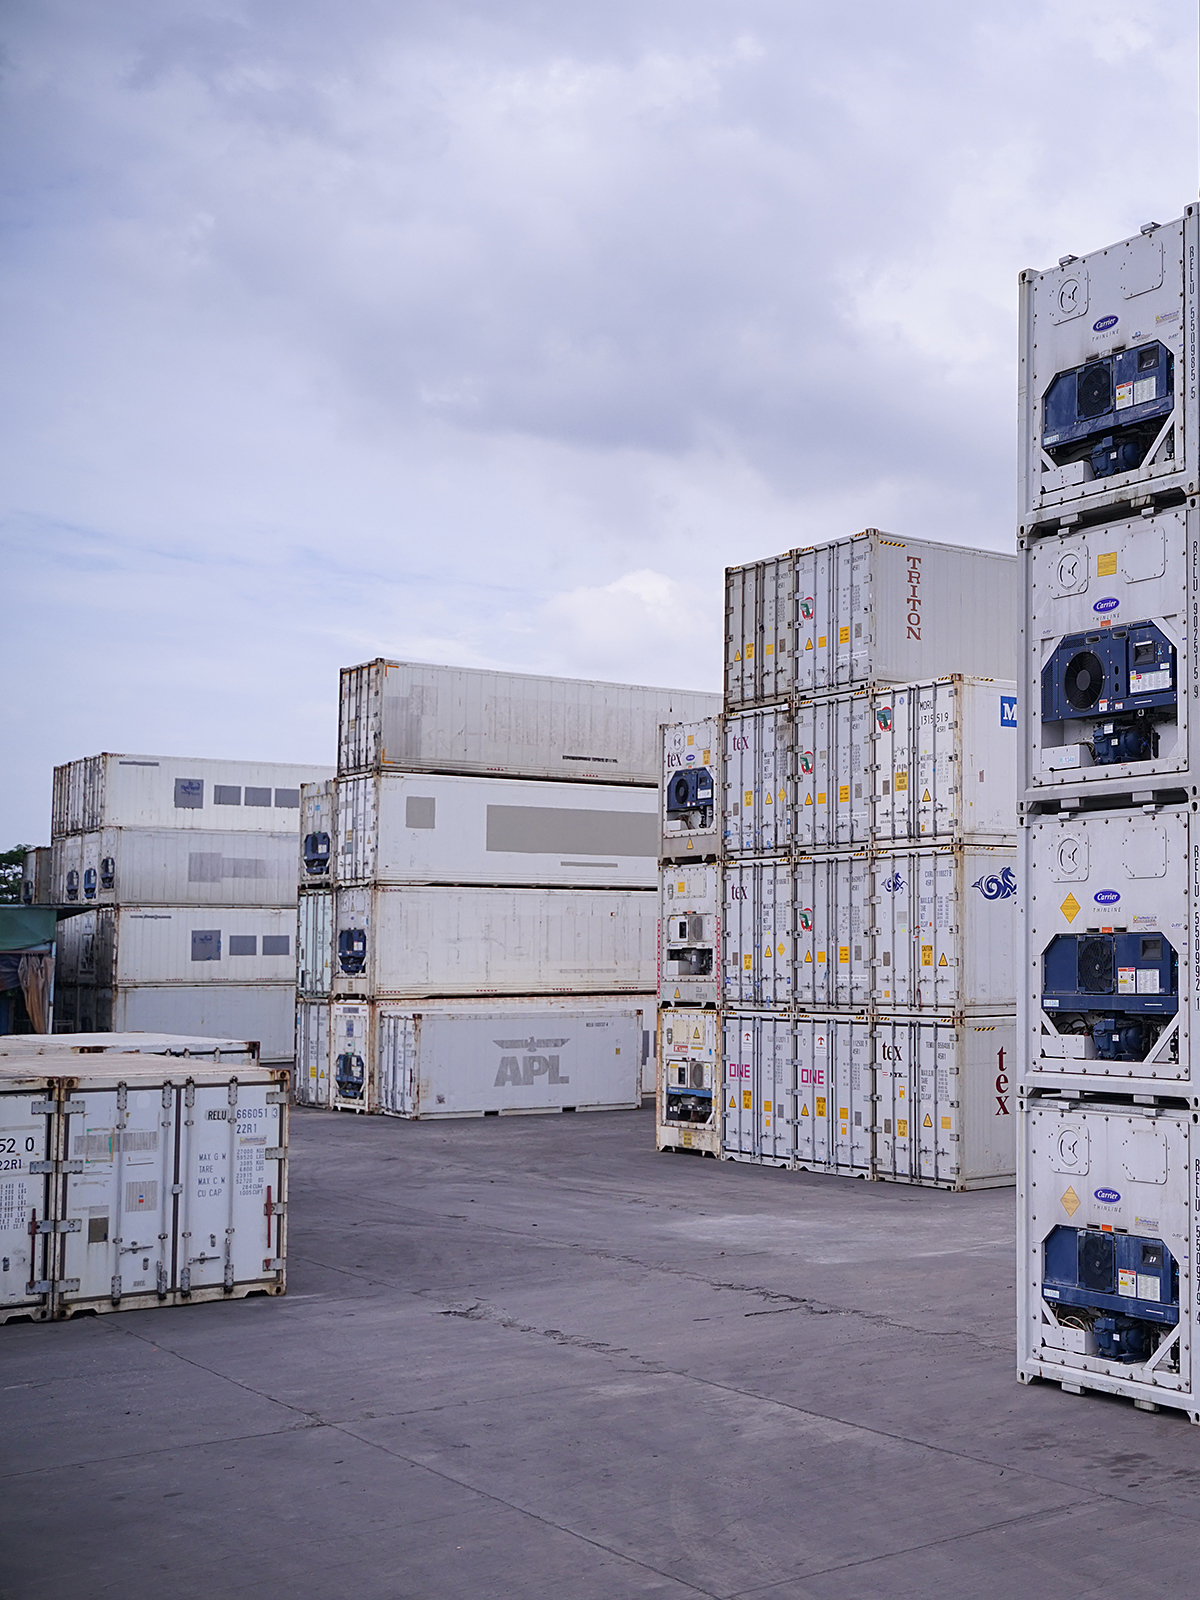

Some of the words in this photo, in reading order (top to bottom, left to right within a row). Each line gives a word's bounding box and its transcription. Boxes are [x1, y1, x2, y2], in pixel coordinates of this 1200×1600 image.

[1094, 316, 1117, 331] Carrier
[907, 556, 921, 640] TRITON
[1096, 599, 1118, 611] Carrier
[733, 734, 749, 751] tex
[668, 752, 682, 767] tex
[731, 884, 747, 900] tex
[1098, 891, 1118, 901] Carrier
[882, 1041, 902, 1061] tex
[493, 1054, 569, 1087] APL
[730, 1064, 750, 1078] ONE
[801, 1068, 824, 1084] ONE
[995, 1046, 1010, 1116] tex
[208, 1111, 226, 1120] RELU
[237, 1108, 267, 1119] 666051
[273, 1108, 278, 1118] 3
[237, 1124, 257, 1134] 22R1
[26, 1137, 34, 1151] 0
[199, 1153, 211, 1161] MAX
[199, 1165, 213, 1173] TARE
[198, 1177, 210, 1185] MAX
[1098, 1190, 1118, 1200] Carrier
